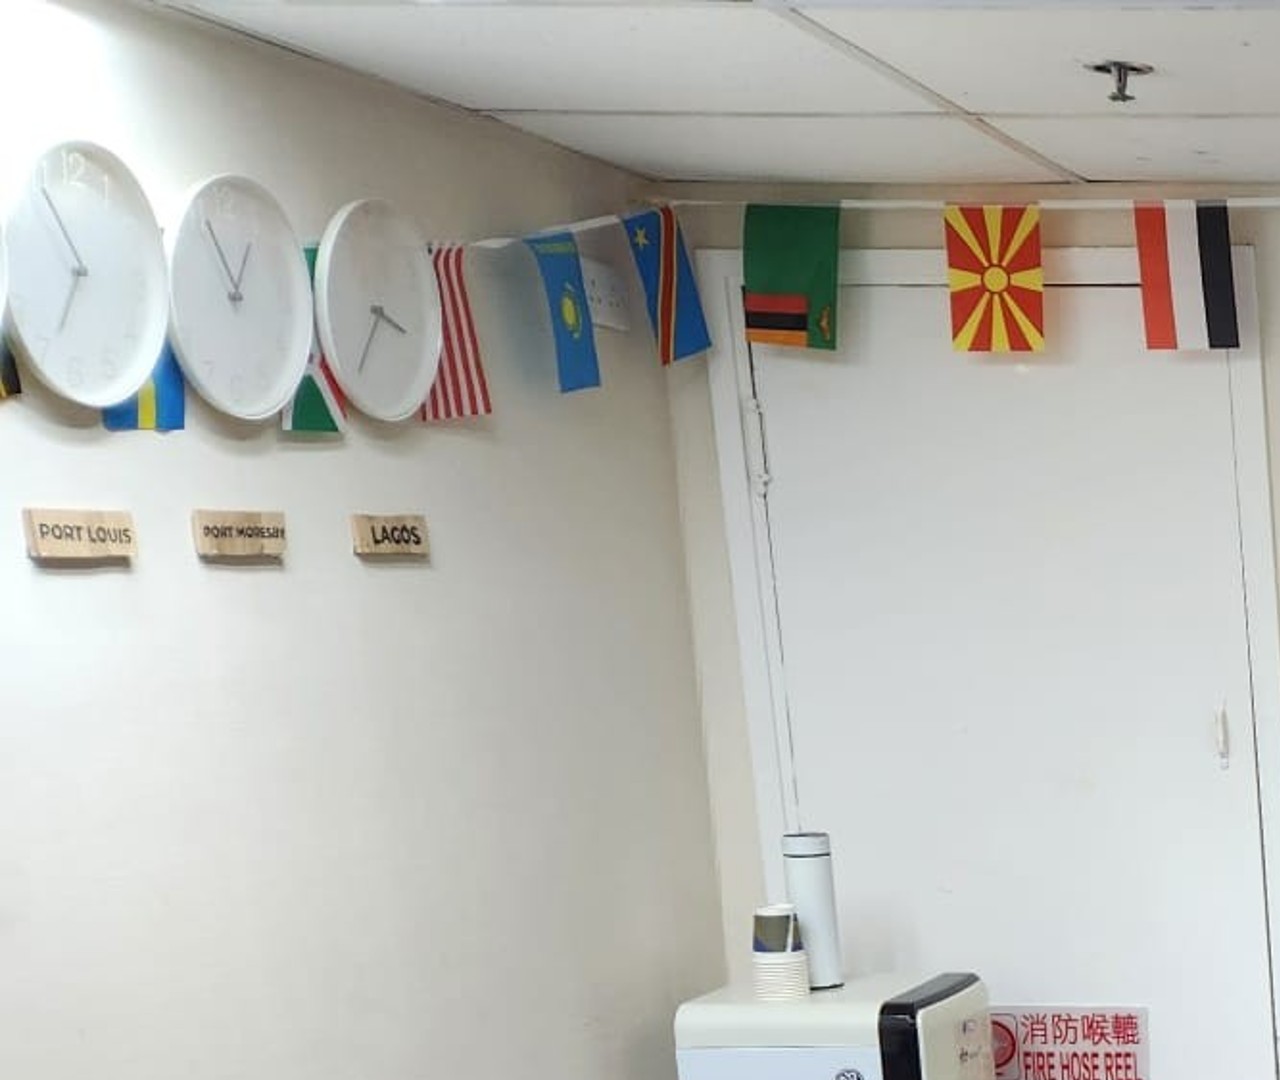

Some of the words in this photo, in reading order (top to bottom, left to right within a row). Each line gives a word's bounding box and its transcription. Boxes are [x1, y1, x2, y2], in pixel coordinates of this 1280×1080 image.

[39, 522, 82, 542] PORT
[87, 525, 132, 544] LOUIS
[203, 525, 233, 539] PORT
[371, 524, 422, 545] LAGOS
